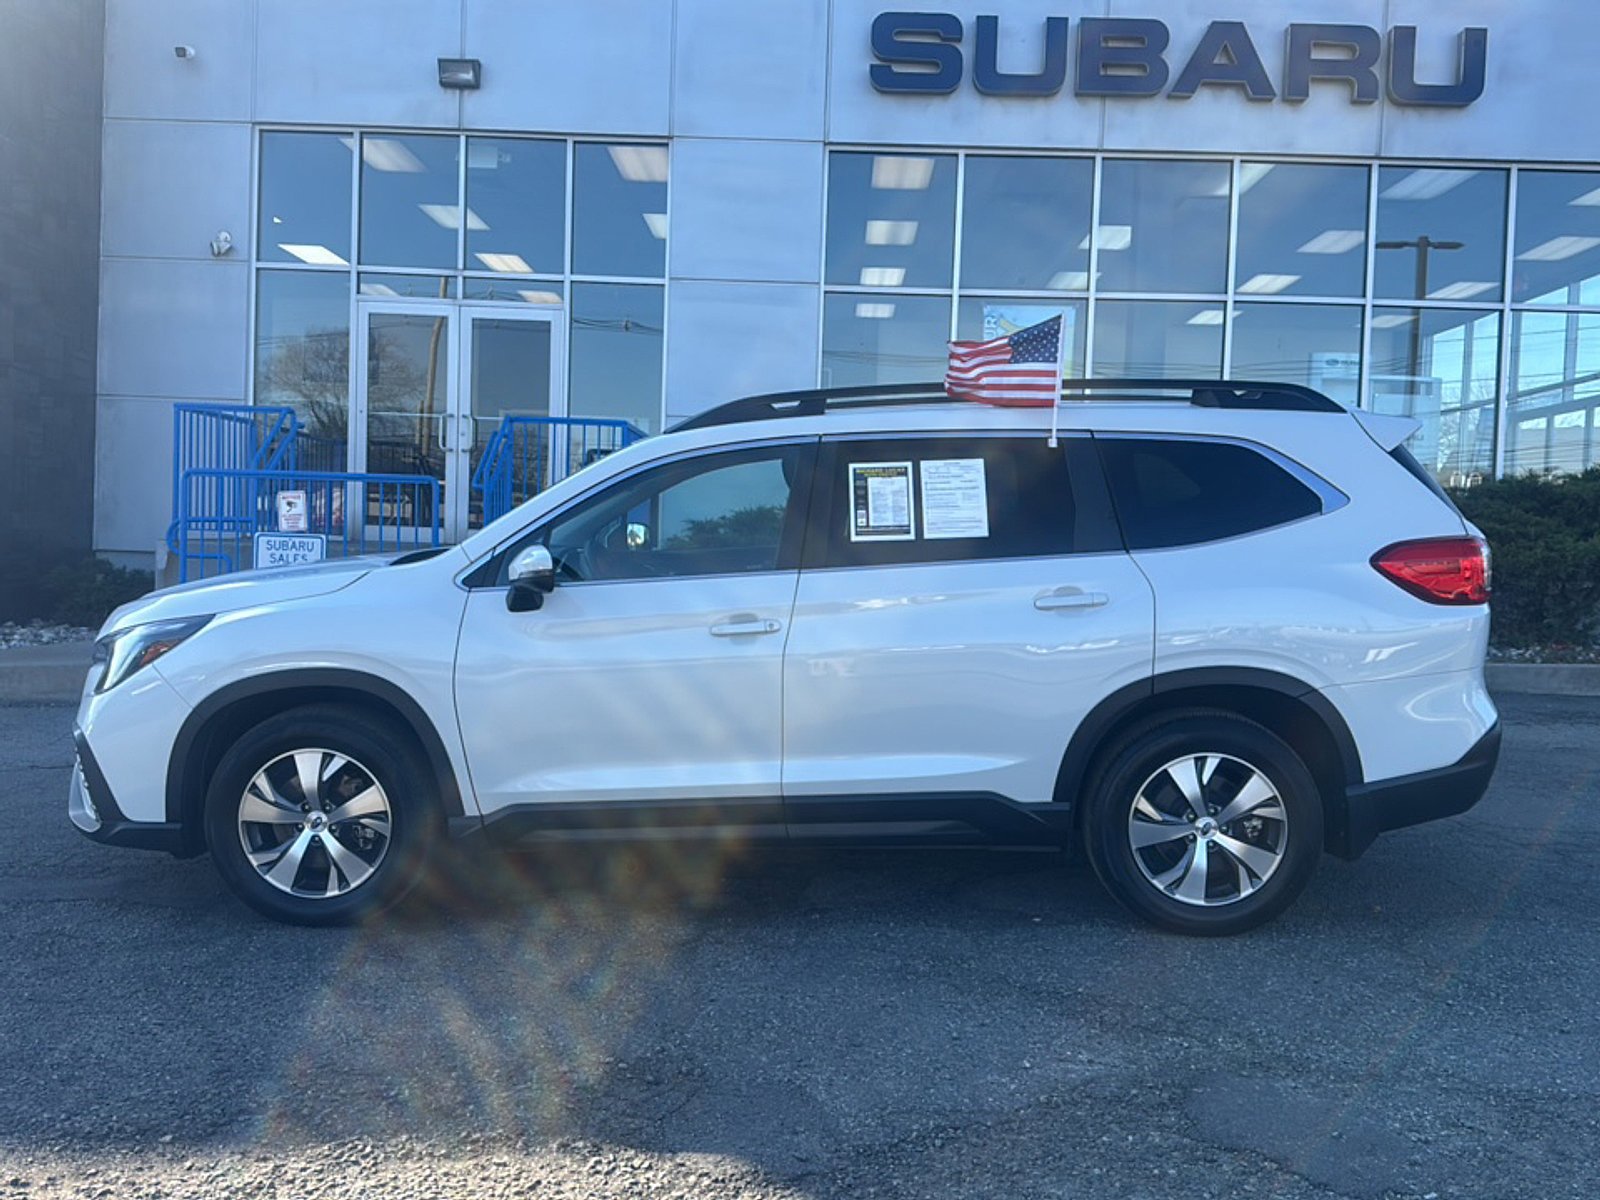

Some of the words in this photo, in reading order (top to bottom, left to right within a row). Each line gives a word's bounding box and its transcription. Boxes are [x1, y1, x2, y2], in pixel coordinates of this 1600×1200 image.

[869, 11, 1489, 107] SUBARU
[266, 540, 314, 552] SUBARU
[269, 553, 308, 565] SALES
